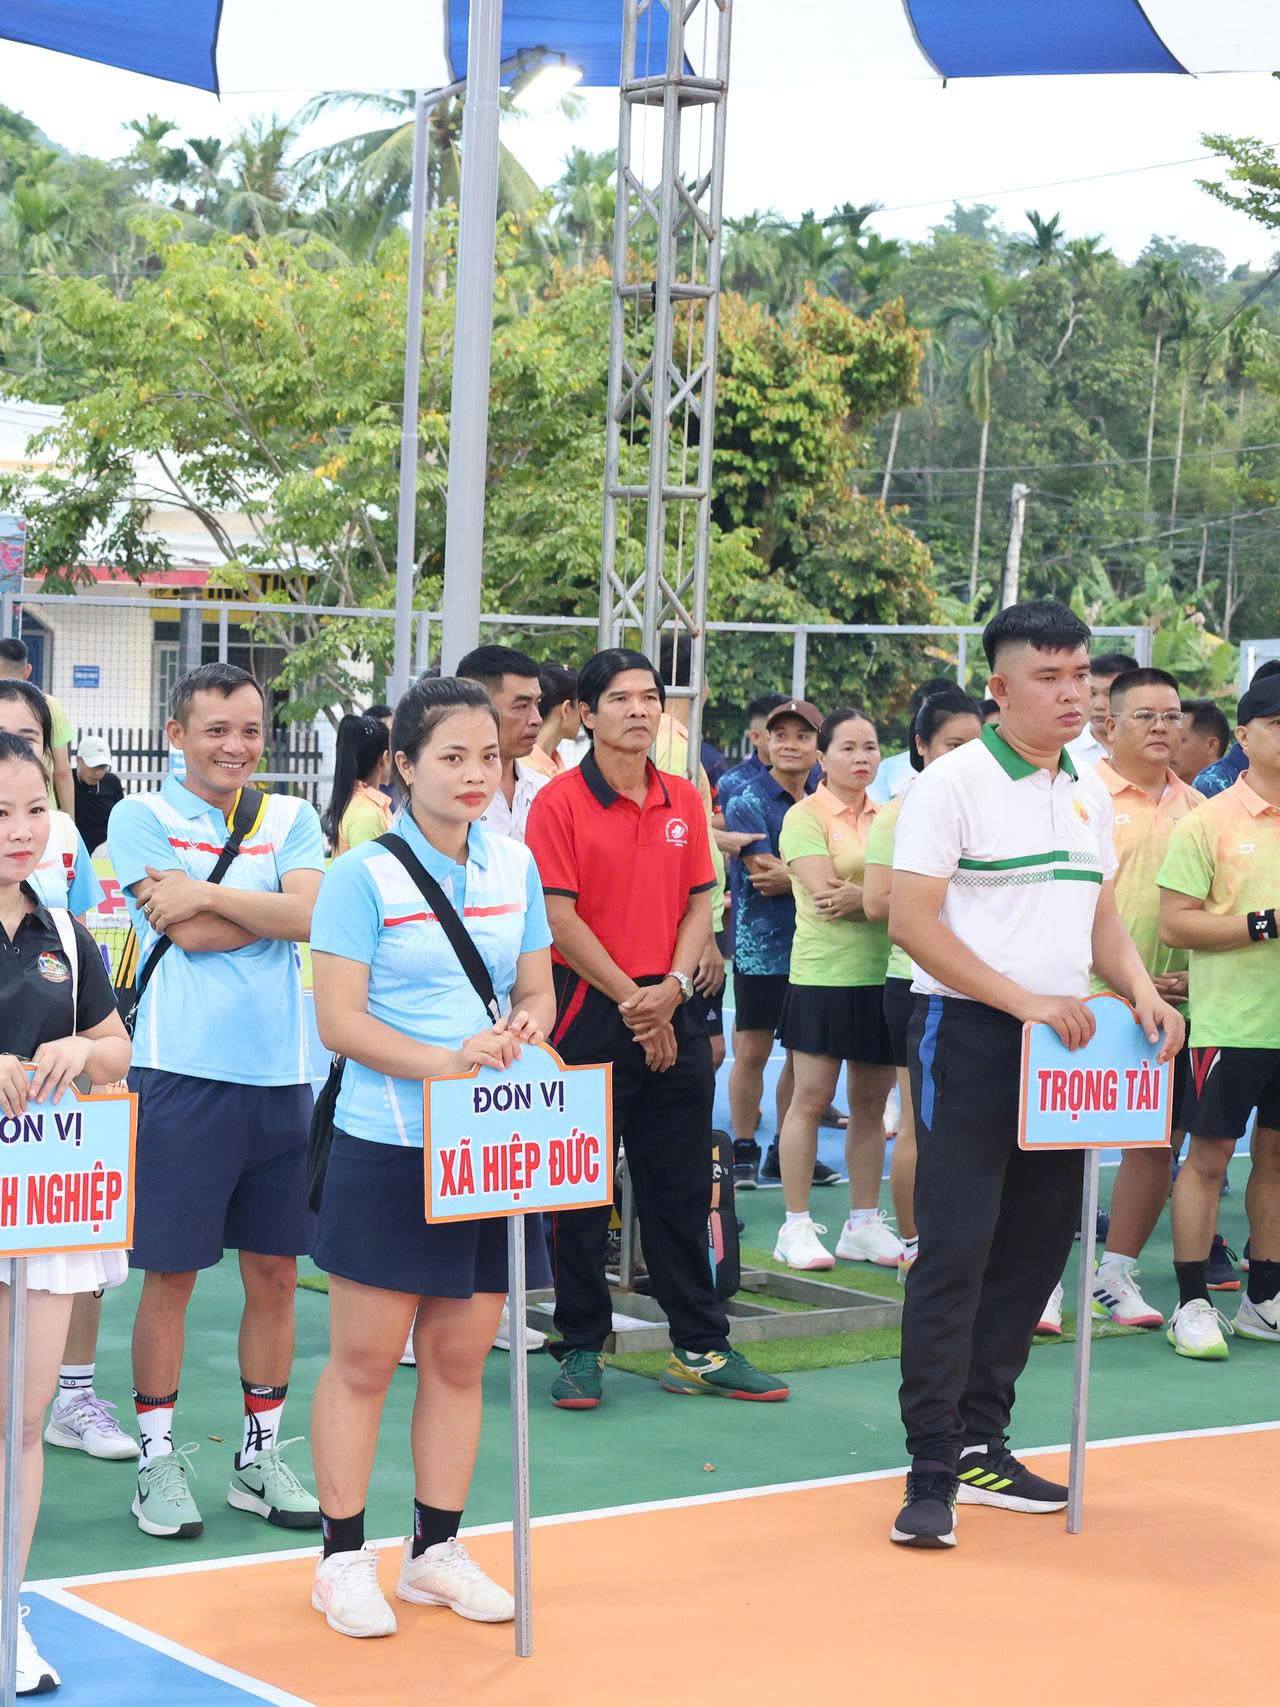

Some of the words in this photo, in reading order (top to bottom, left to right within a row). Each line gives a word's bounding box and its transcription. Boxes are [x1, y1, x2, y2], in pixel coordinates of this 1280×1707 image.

[473, 1082, 532, 1113] ĐƠN
[540, 1081, 564, 1112] VỊ
[1038, 1070, 1118, 1121] TRỌNG
[1125, 1061, 1160, 1110] TÀI
[54, 1112, 82, 1146] VỊ
[440, 1138, 475, 1196] XÃ
[482, 1133, 541, 1200] HIỆP
[548, 1128, 599, 1186] ĐỨC
[26, 1161, 122, 1232] NGHIỆP
